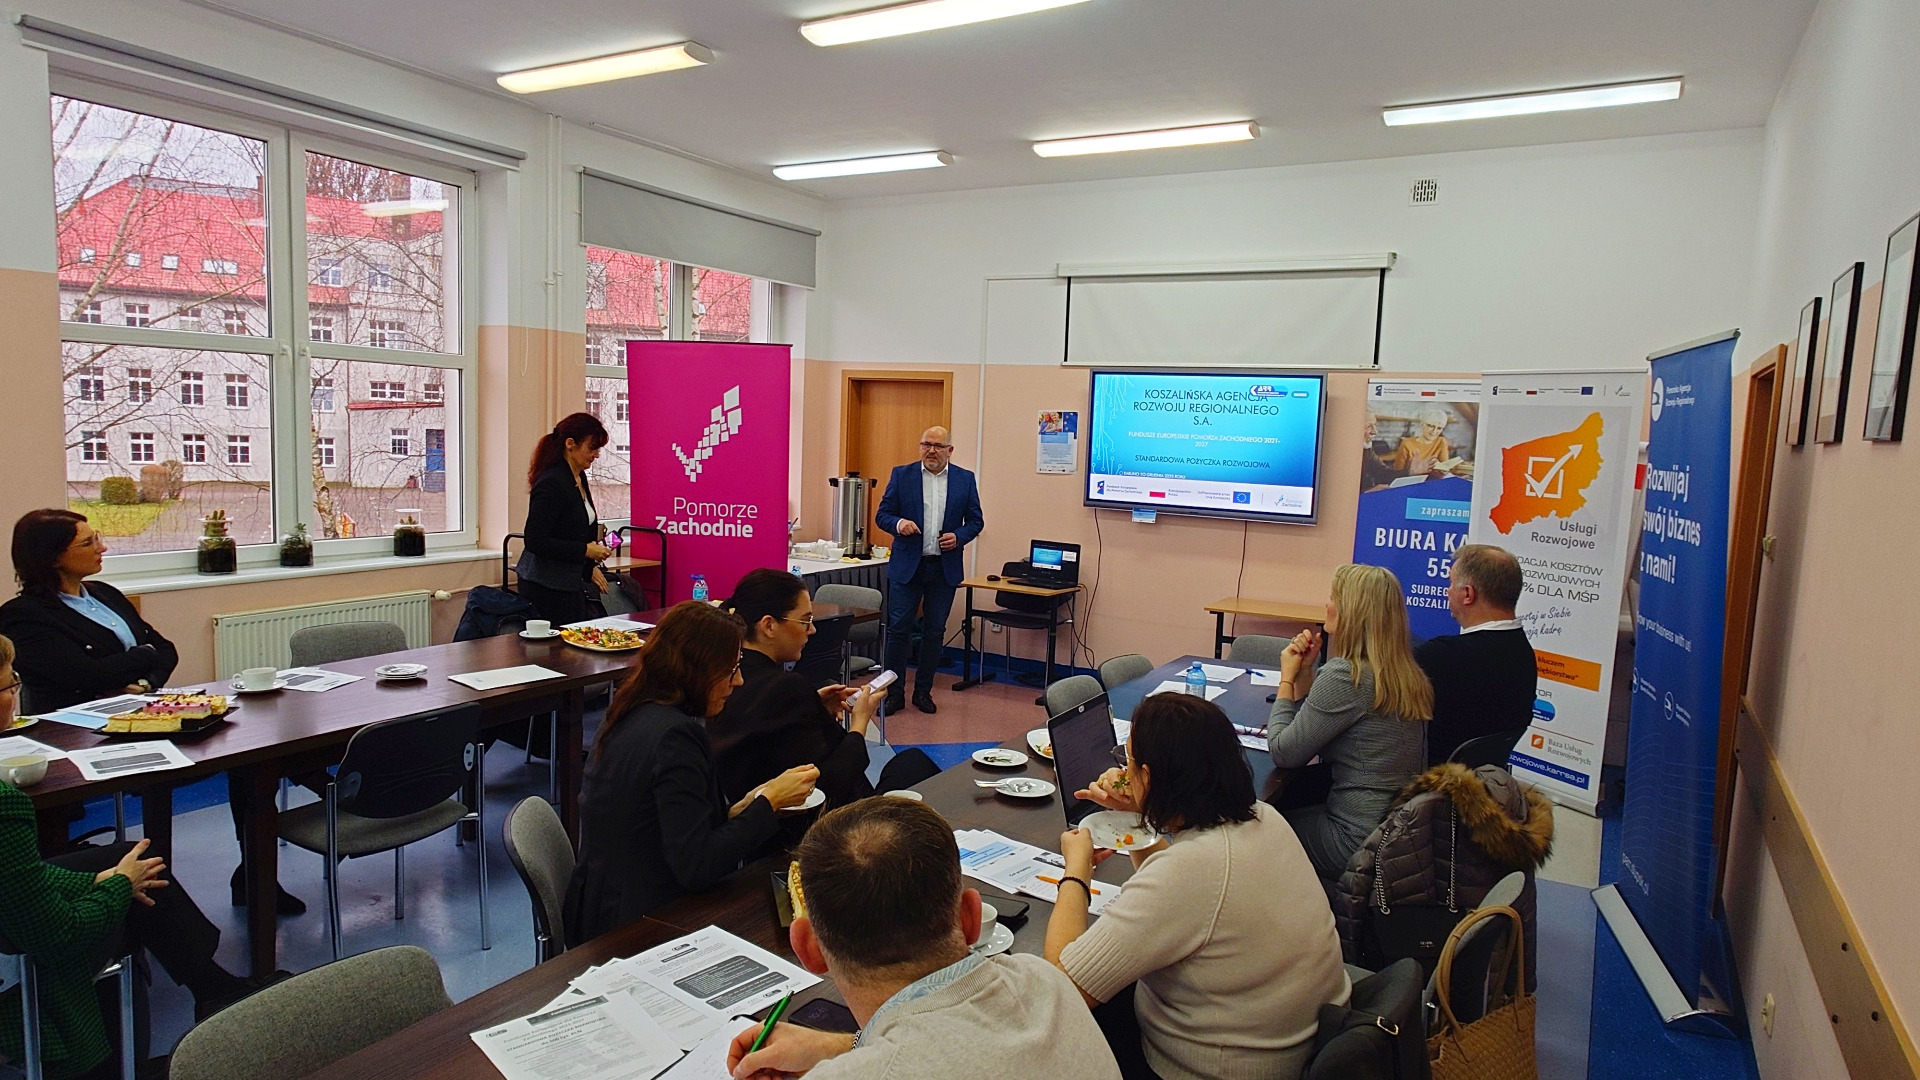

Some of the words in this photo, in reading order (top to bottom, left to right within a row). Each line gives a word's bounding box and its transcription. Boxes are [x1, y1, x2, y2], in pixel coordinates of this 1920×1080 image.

[1144, 389, 1212, 400] KOSZALIŃSKA
[1134, 402, 1185, 412] ROZWOJU
[1189, 404, 1279, 415] REGIONALNEGO
[1193, 416, 1212, 426] S.A.
[1135, 455, 1185, 464] STANDARDOWA
[1186, 456, 1220, 466] POŻYCZKA
[1223, 460, 1270, 468] ROZWOJOWA
[1646, 462, 1690, 502] Rozwijaj
[673, 497, 758, 518] Pomorze
[1421, 507, 1470, 518] zapraszam
[655, 516, 753, 538] Zachodnie
[1560, 520, 1597, 537] Usługi
[1642, 506, 1666, 542] swój
[1668, 510, 1700, 547] biznes
[1375, 528, 1436, 551] BIURA
[1444, 532, 1469, 552] KA
[1531, 532, 1595, 549] Rozwojowe
[1517, 556, 1548, 568] DACJA
[1550, 561, 1603, 576] KOSZTÓW
[1646, 552, 1676, 584] nami!
[1411, 584, 1449, 596] SUBREG
[1538, 585, 1563, 598] DLA
[1568, 589, 1600, 603] MŚP
[1406, 596, 1450, 609] KOSZALI
[1548, 606, 1571, 618] Siebie
[1540, 623, 1562, 635] kadrę
[1548, 738, 1563, 749] Baza
[1564, 743, 1582, 756] Usług
[1548, 747, 1591, 766] Rozwojowych
[1509, 754, 1585, 783] ozwojowe.karrsa.pl
